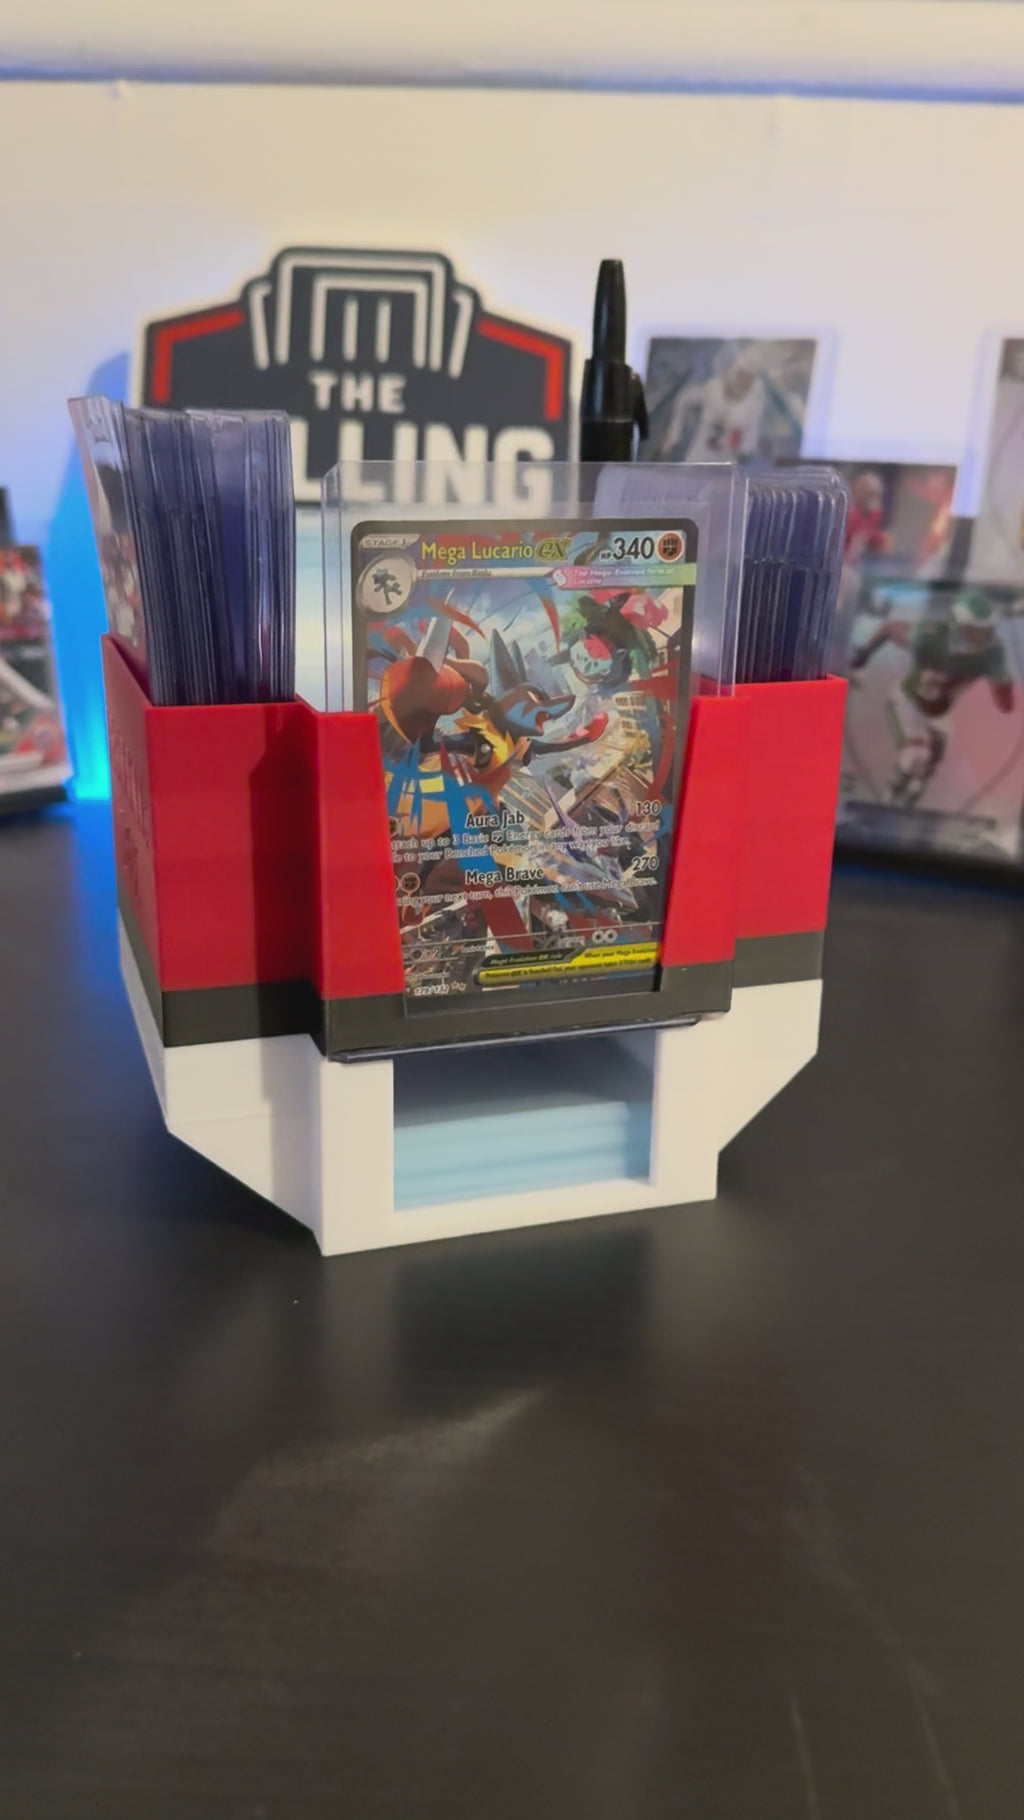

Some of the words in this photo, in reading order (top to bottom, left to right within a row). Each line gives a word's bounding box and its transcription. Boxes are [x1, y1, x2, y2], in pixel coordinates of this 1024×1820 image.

[310, 372, 405, 413] THE
[290, 415, 555, 508] LLING
[365, 539, 399, 548] STAGE
[421, 541, 466, 566] Mega
[471, 539, 534, 561] Lucario
[535, 537, 571, 562] ex
[612, 536, 654, 561] 340
[635, 799, 661, 816] 130
[465, 813, 498, 828] Aura
[500, 810, 525, 829] Jab
[391, 838, 419, 850] ttach
[421, 839, 437, 850] up
[437, 836, 451, 847] to
[462, 832, 490, 845] Basic
[599, 823, 623, 836] your
[403, 852, 416, 863] to
[418, 849, 443, 864] your
[444, 845, 489, 859] Benched
[631, 856, 660, 872] 270
[465, 869, 501, 886] Mega
[504, 865, 545, 881] Brave
